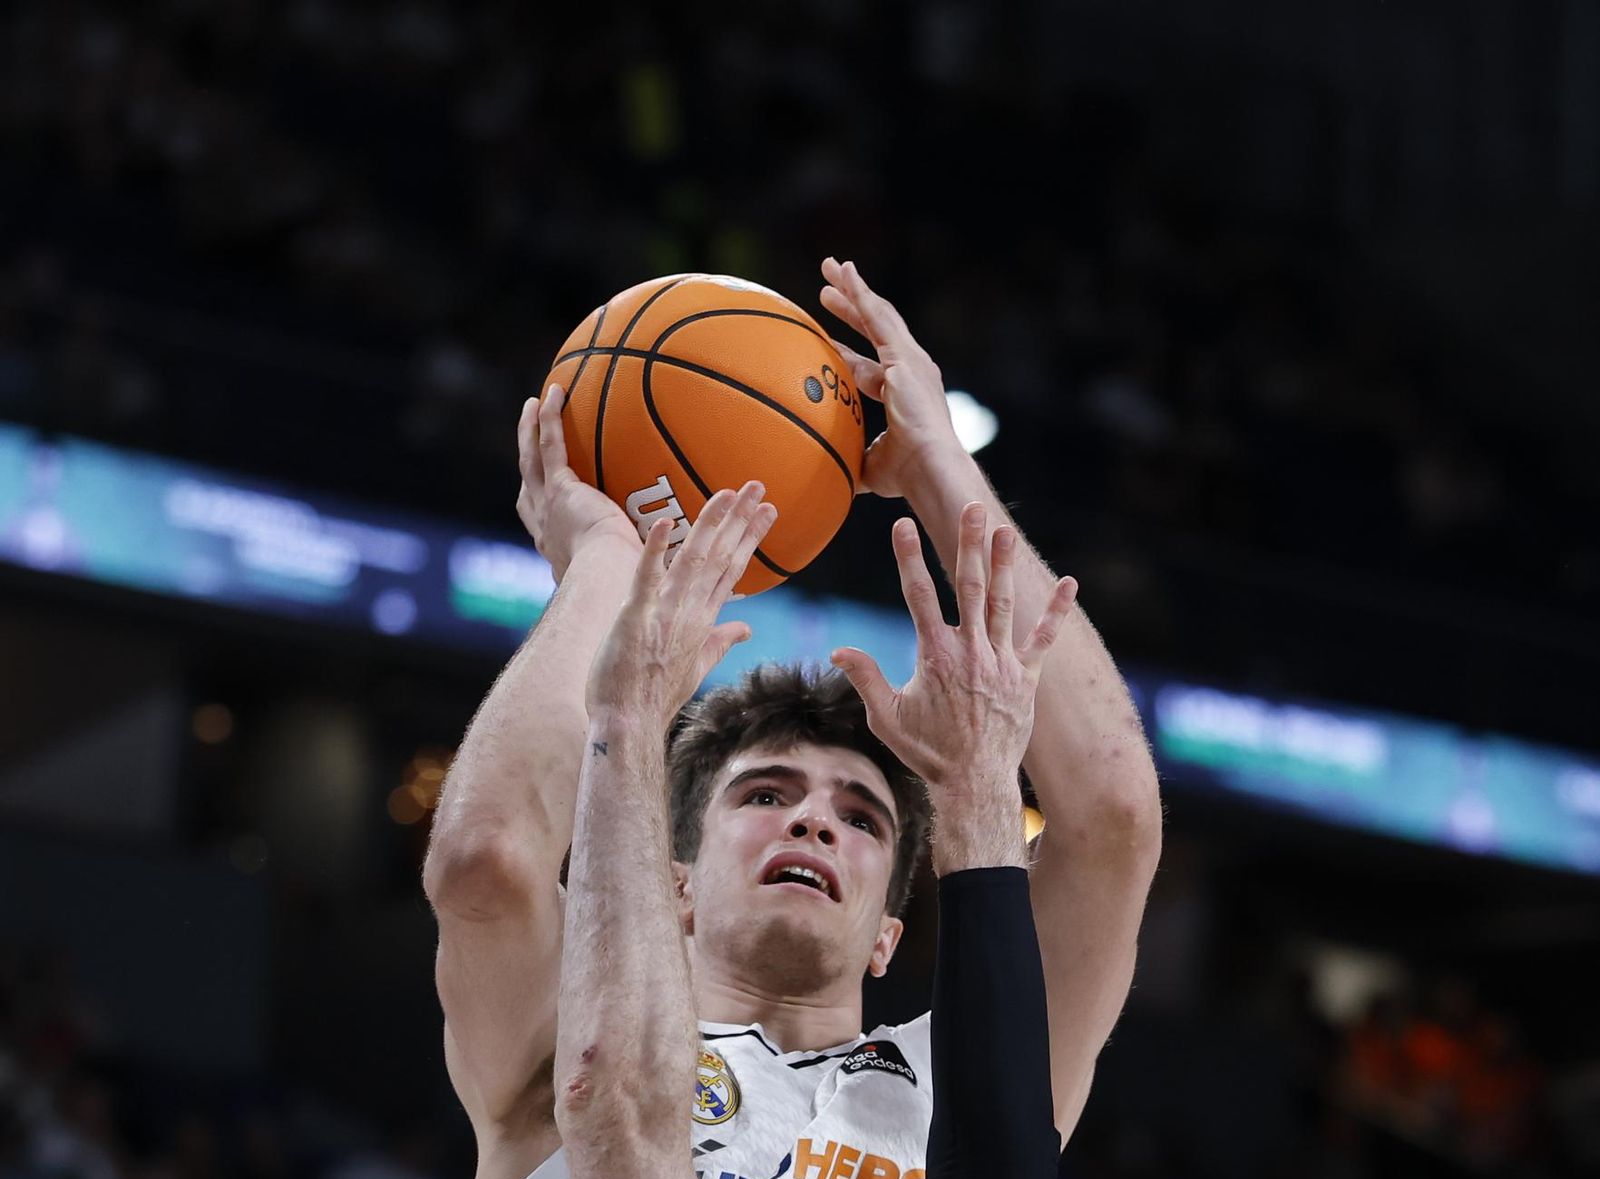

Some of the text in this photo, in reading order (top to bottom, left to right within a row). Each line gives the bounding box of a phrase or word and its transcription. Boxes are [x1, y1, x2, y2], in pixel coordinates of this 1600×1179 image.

[821, 364, 862, 426] acb
[844, 1050, 878, 1066] liga
[850, 1058, 914, 1080] endesa
